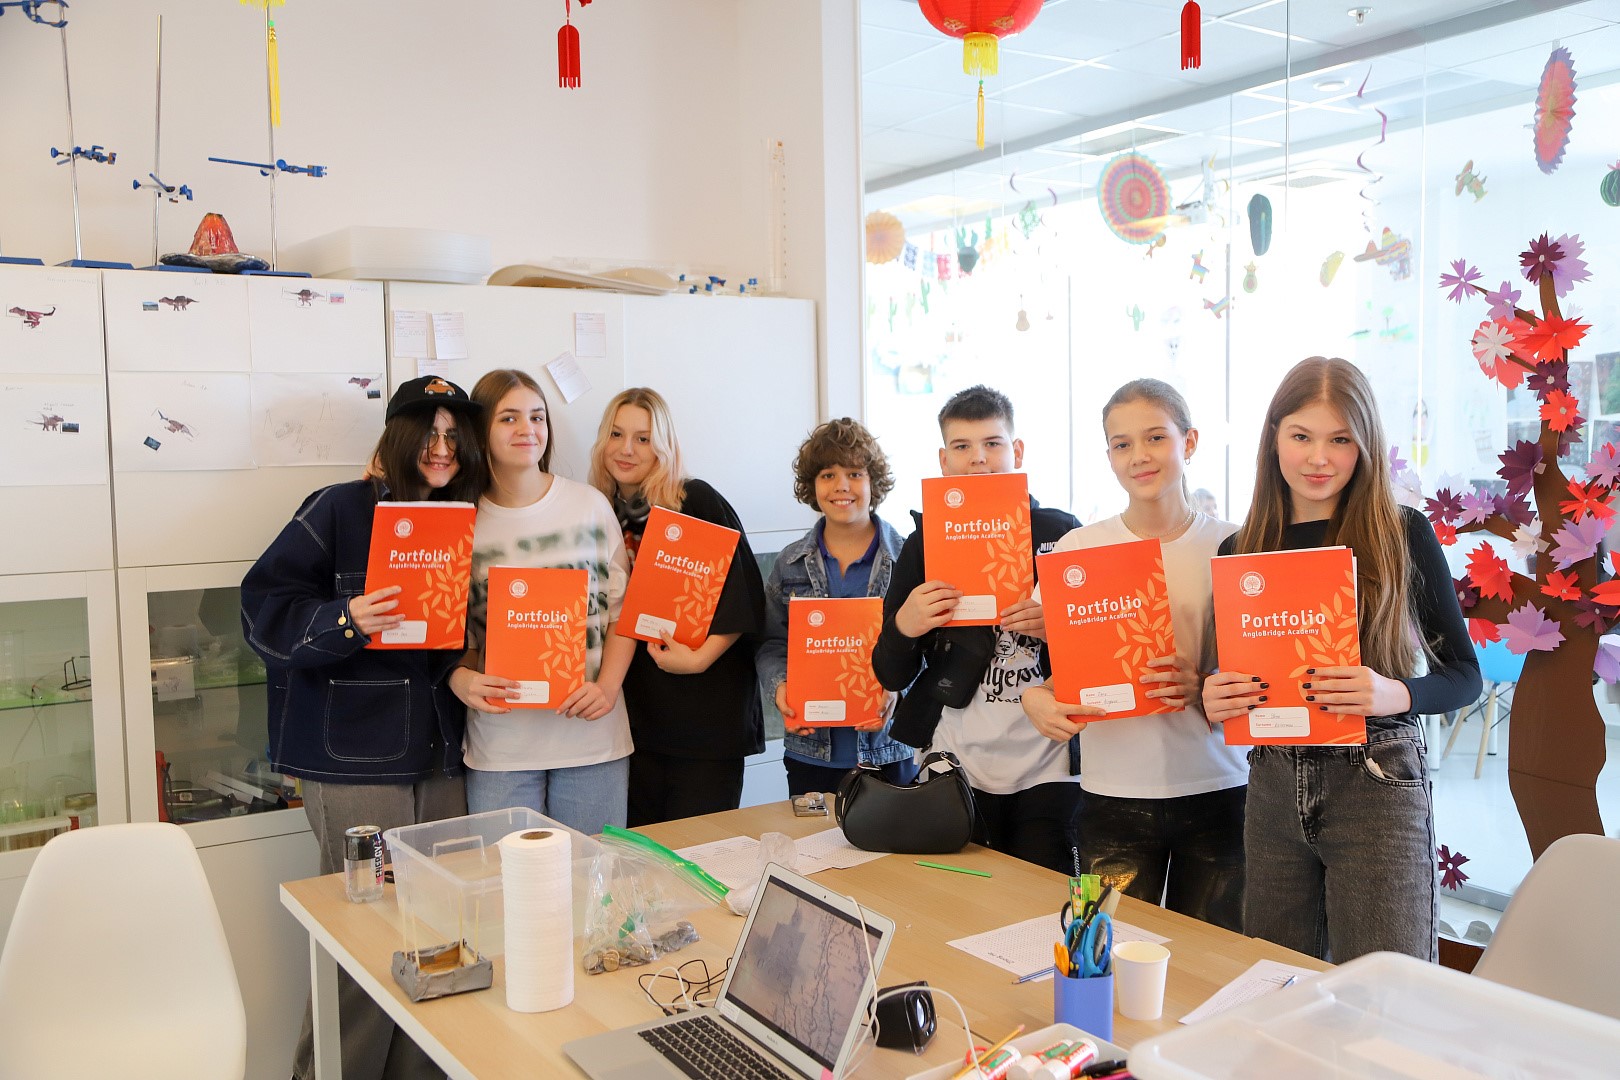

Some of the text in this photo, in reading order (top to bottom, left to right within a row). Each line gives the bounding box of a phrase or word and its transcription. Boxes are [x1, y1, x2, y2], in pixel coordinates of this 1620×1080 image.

[945, 519, 1010, 533] Portfolio
[945, 532, 1005, 541] AngloBridge Academy
[390, 550, 451, 562] Portfolio
[656, 550, 711, 575] Portfolio
[389, 562, 420, 570] AngloBridge
[654, 562, 703, 579] AngloBridge Academy
[1066, 595, 1142, 617] Portfolio
[507, 610, 568, 623] Portfolio
[1069, 610, 1137, 626] AngloBridge Academy
[1241, 610, 1326, 629] Portfolio
[540, 622, 563, 630] Academy
[1242, 627, 1319, 639] AngloBridge Academy
[806, 636, 863, 648] Portfolio
[375, 846, 383, 878] ENERGY
